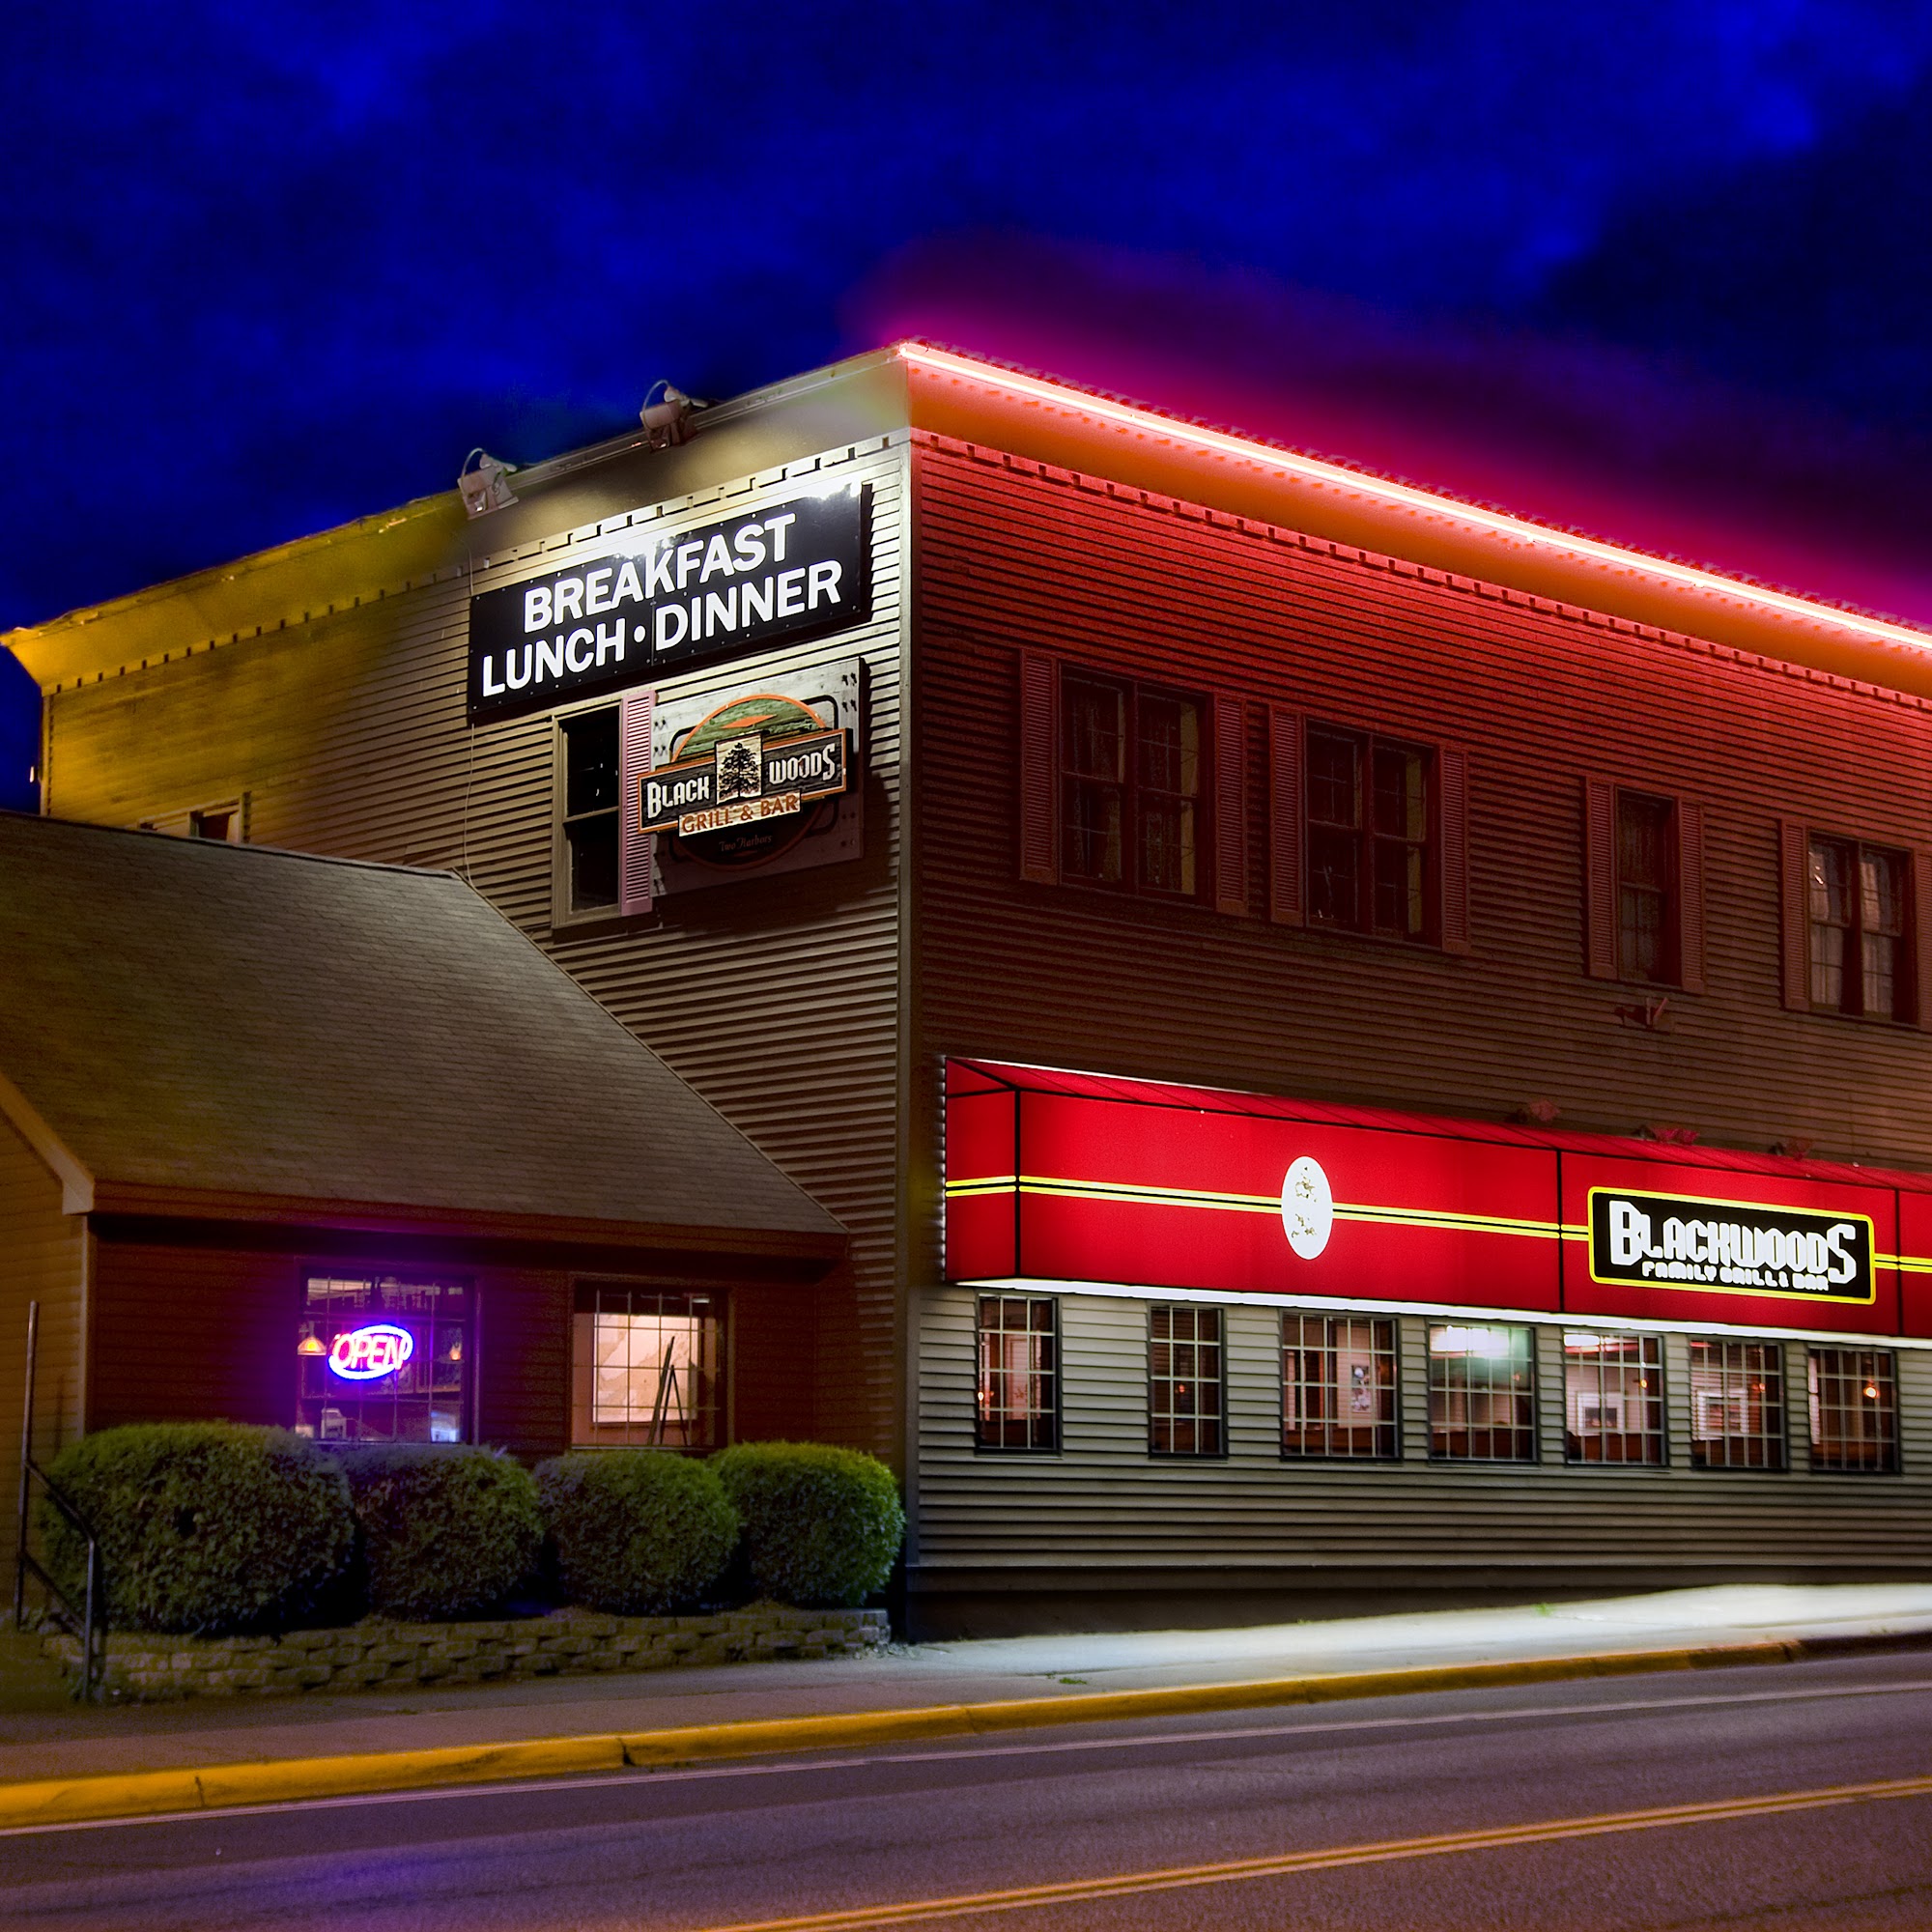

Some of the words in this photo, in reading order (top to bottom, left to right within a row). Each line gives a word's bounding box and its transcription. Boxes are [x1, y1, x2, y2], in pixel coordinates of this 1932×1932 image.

[523, 513, 796, 634] BREAKFAST
[482, 617, 627, 697] LUNCH
[655, 559, 843, 651] DINNER
[646, 776, 711, 819] BLACK
[768, 743, 837, 785] WOODS
[681, 810, 730, 835] GRILL
[740, 806, 753, 821] &
[760, 794, 800, 817] BAR
[718, 838, 736, 852] Two
[1608, 1200, 1858, 1285] BLACKWOODS
[1642, 1261, 1718, 1282] FAMILY
[331, 1333, 408, 1371] OPEN
